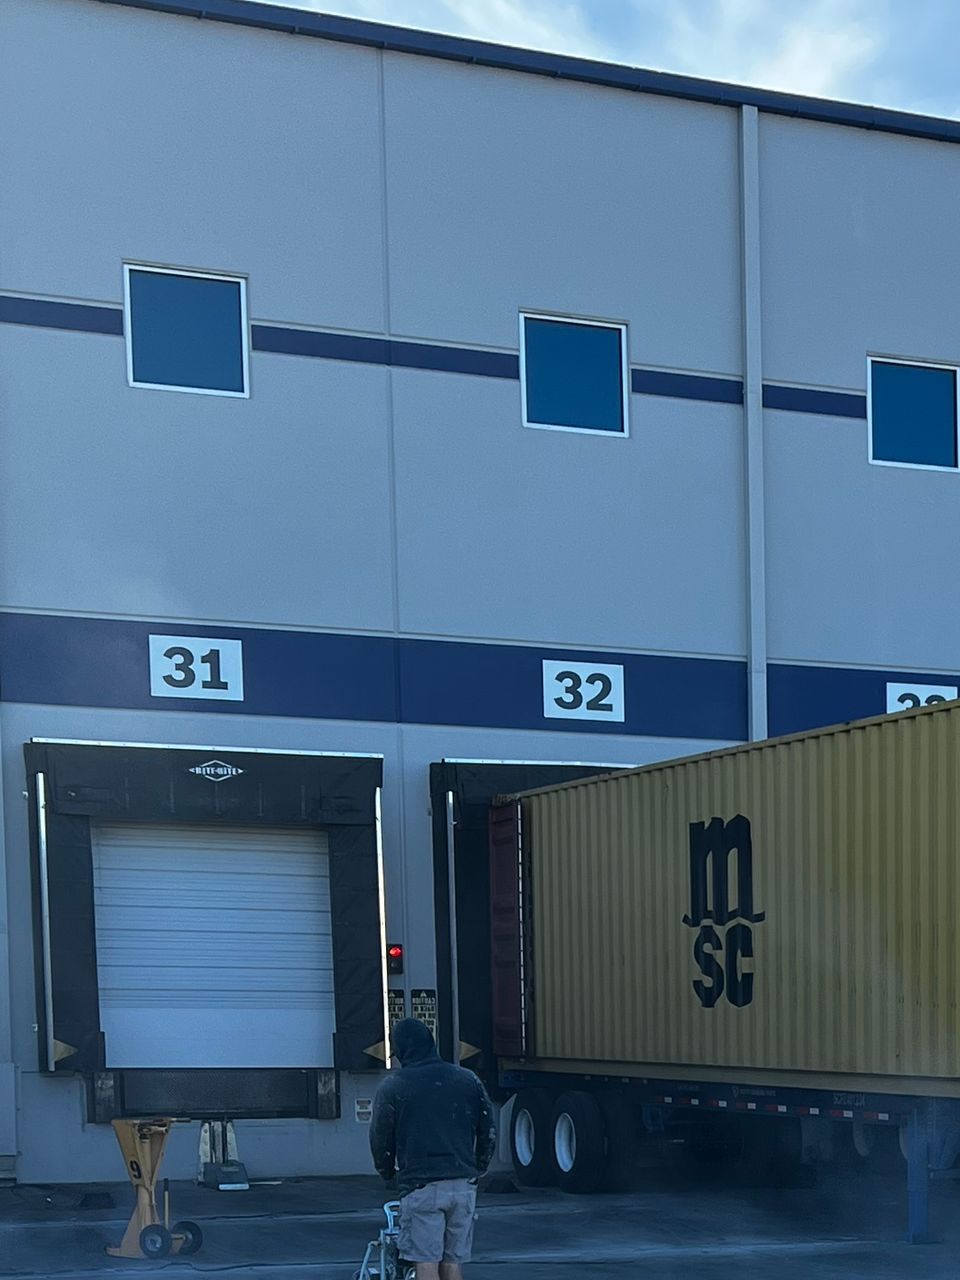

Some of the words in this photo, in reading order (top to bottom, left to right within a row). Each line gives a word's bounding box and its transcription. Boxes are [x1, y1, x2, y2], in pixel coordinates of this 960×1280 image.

[162, 646, 229, 690] 31
[553, 670, 613, 712] 32
[129, 1160, 142, 1179] 9
